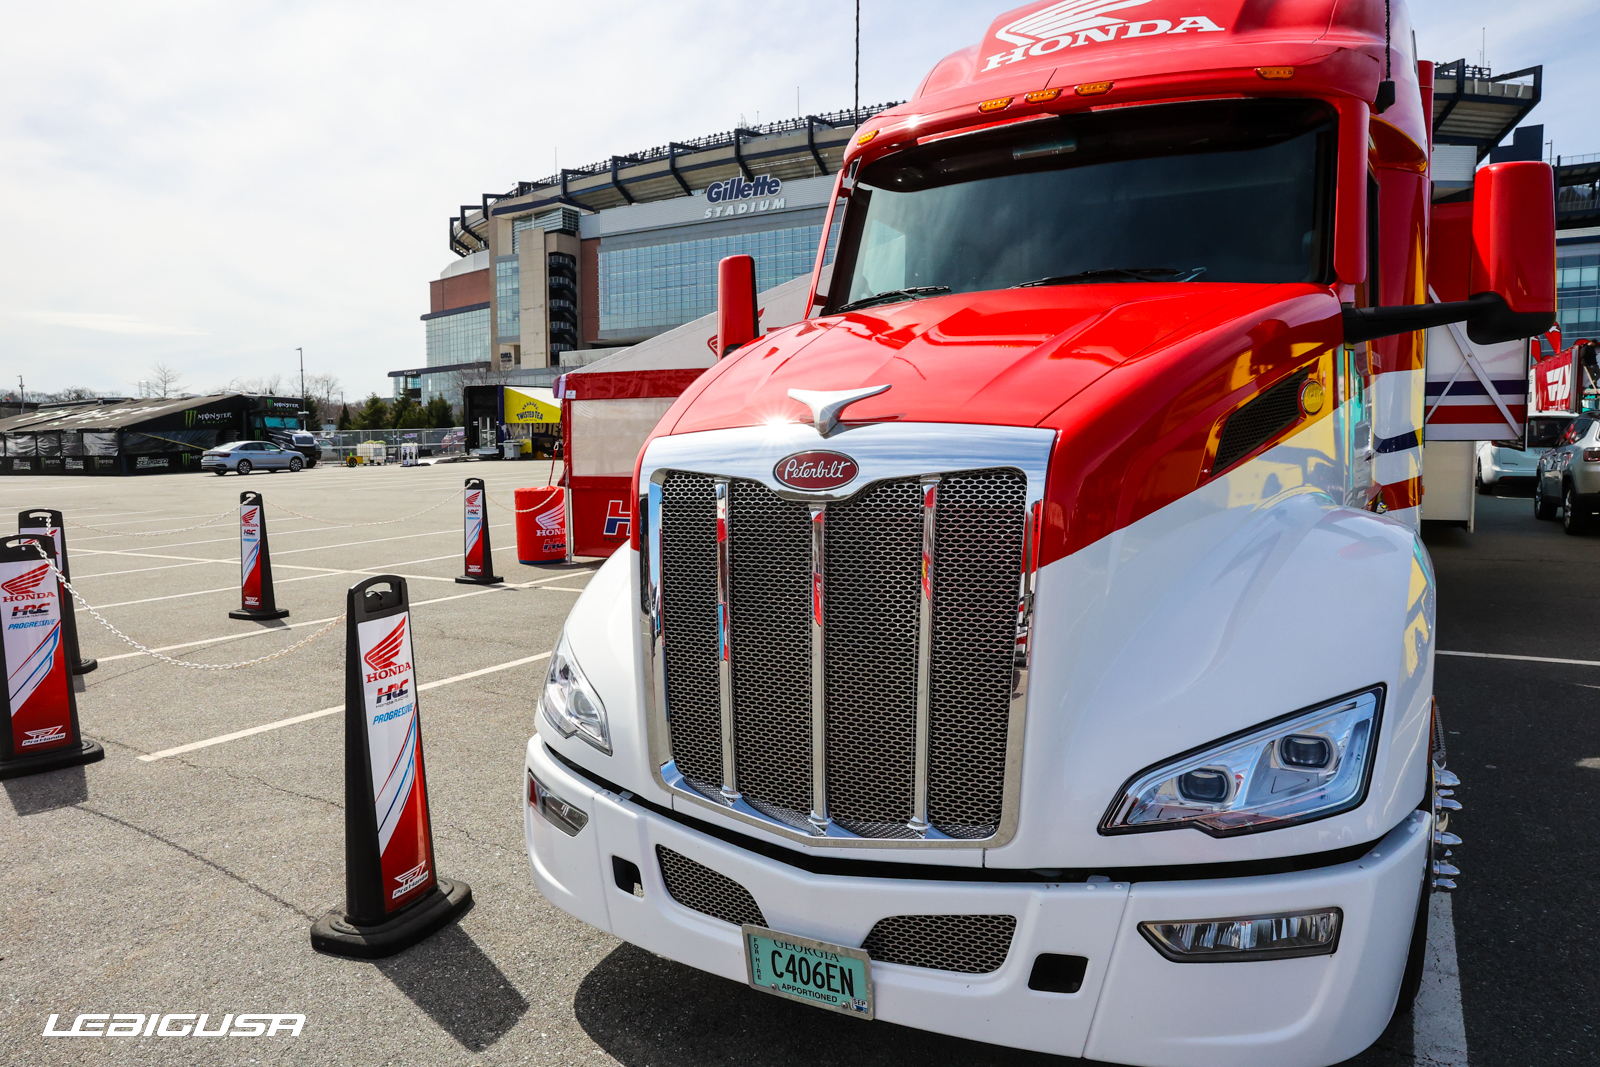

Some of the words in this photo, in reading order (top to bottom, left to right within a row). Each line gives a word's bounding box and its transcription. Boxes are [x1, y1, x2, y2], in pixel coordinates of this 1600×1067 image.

[981, 16, 1225, 72] HONDA
[707, 174, 781, 204] Gillette
[704, 198, 786, 218] STADIUM
[198, 412, 232, 420] MONSTER
[516, 411, 534, 421] TWISTED
[535, 411, 543, 420] TEA
[784, 459, 851, 480] Peterbilt
[2, 592, 56, 603] HONDA
[12, 603, 50, 617] HRC
[8, 619, 57, 630] PROGRESSIVE
[366, 662, 412, 683] HONDA
[376, 678, 409, 704] HRC
[372, 702, 414, 725] PROGRESSIVE
[394, 886, 408, 897] Pro
[409, 873, 428, 889] Honda
[773, 939, 839, 962] GEORGIA
[771, 950, 855, 997] C406EN
[782, 983, 838, 1003] APPORTIONED
